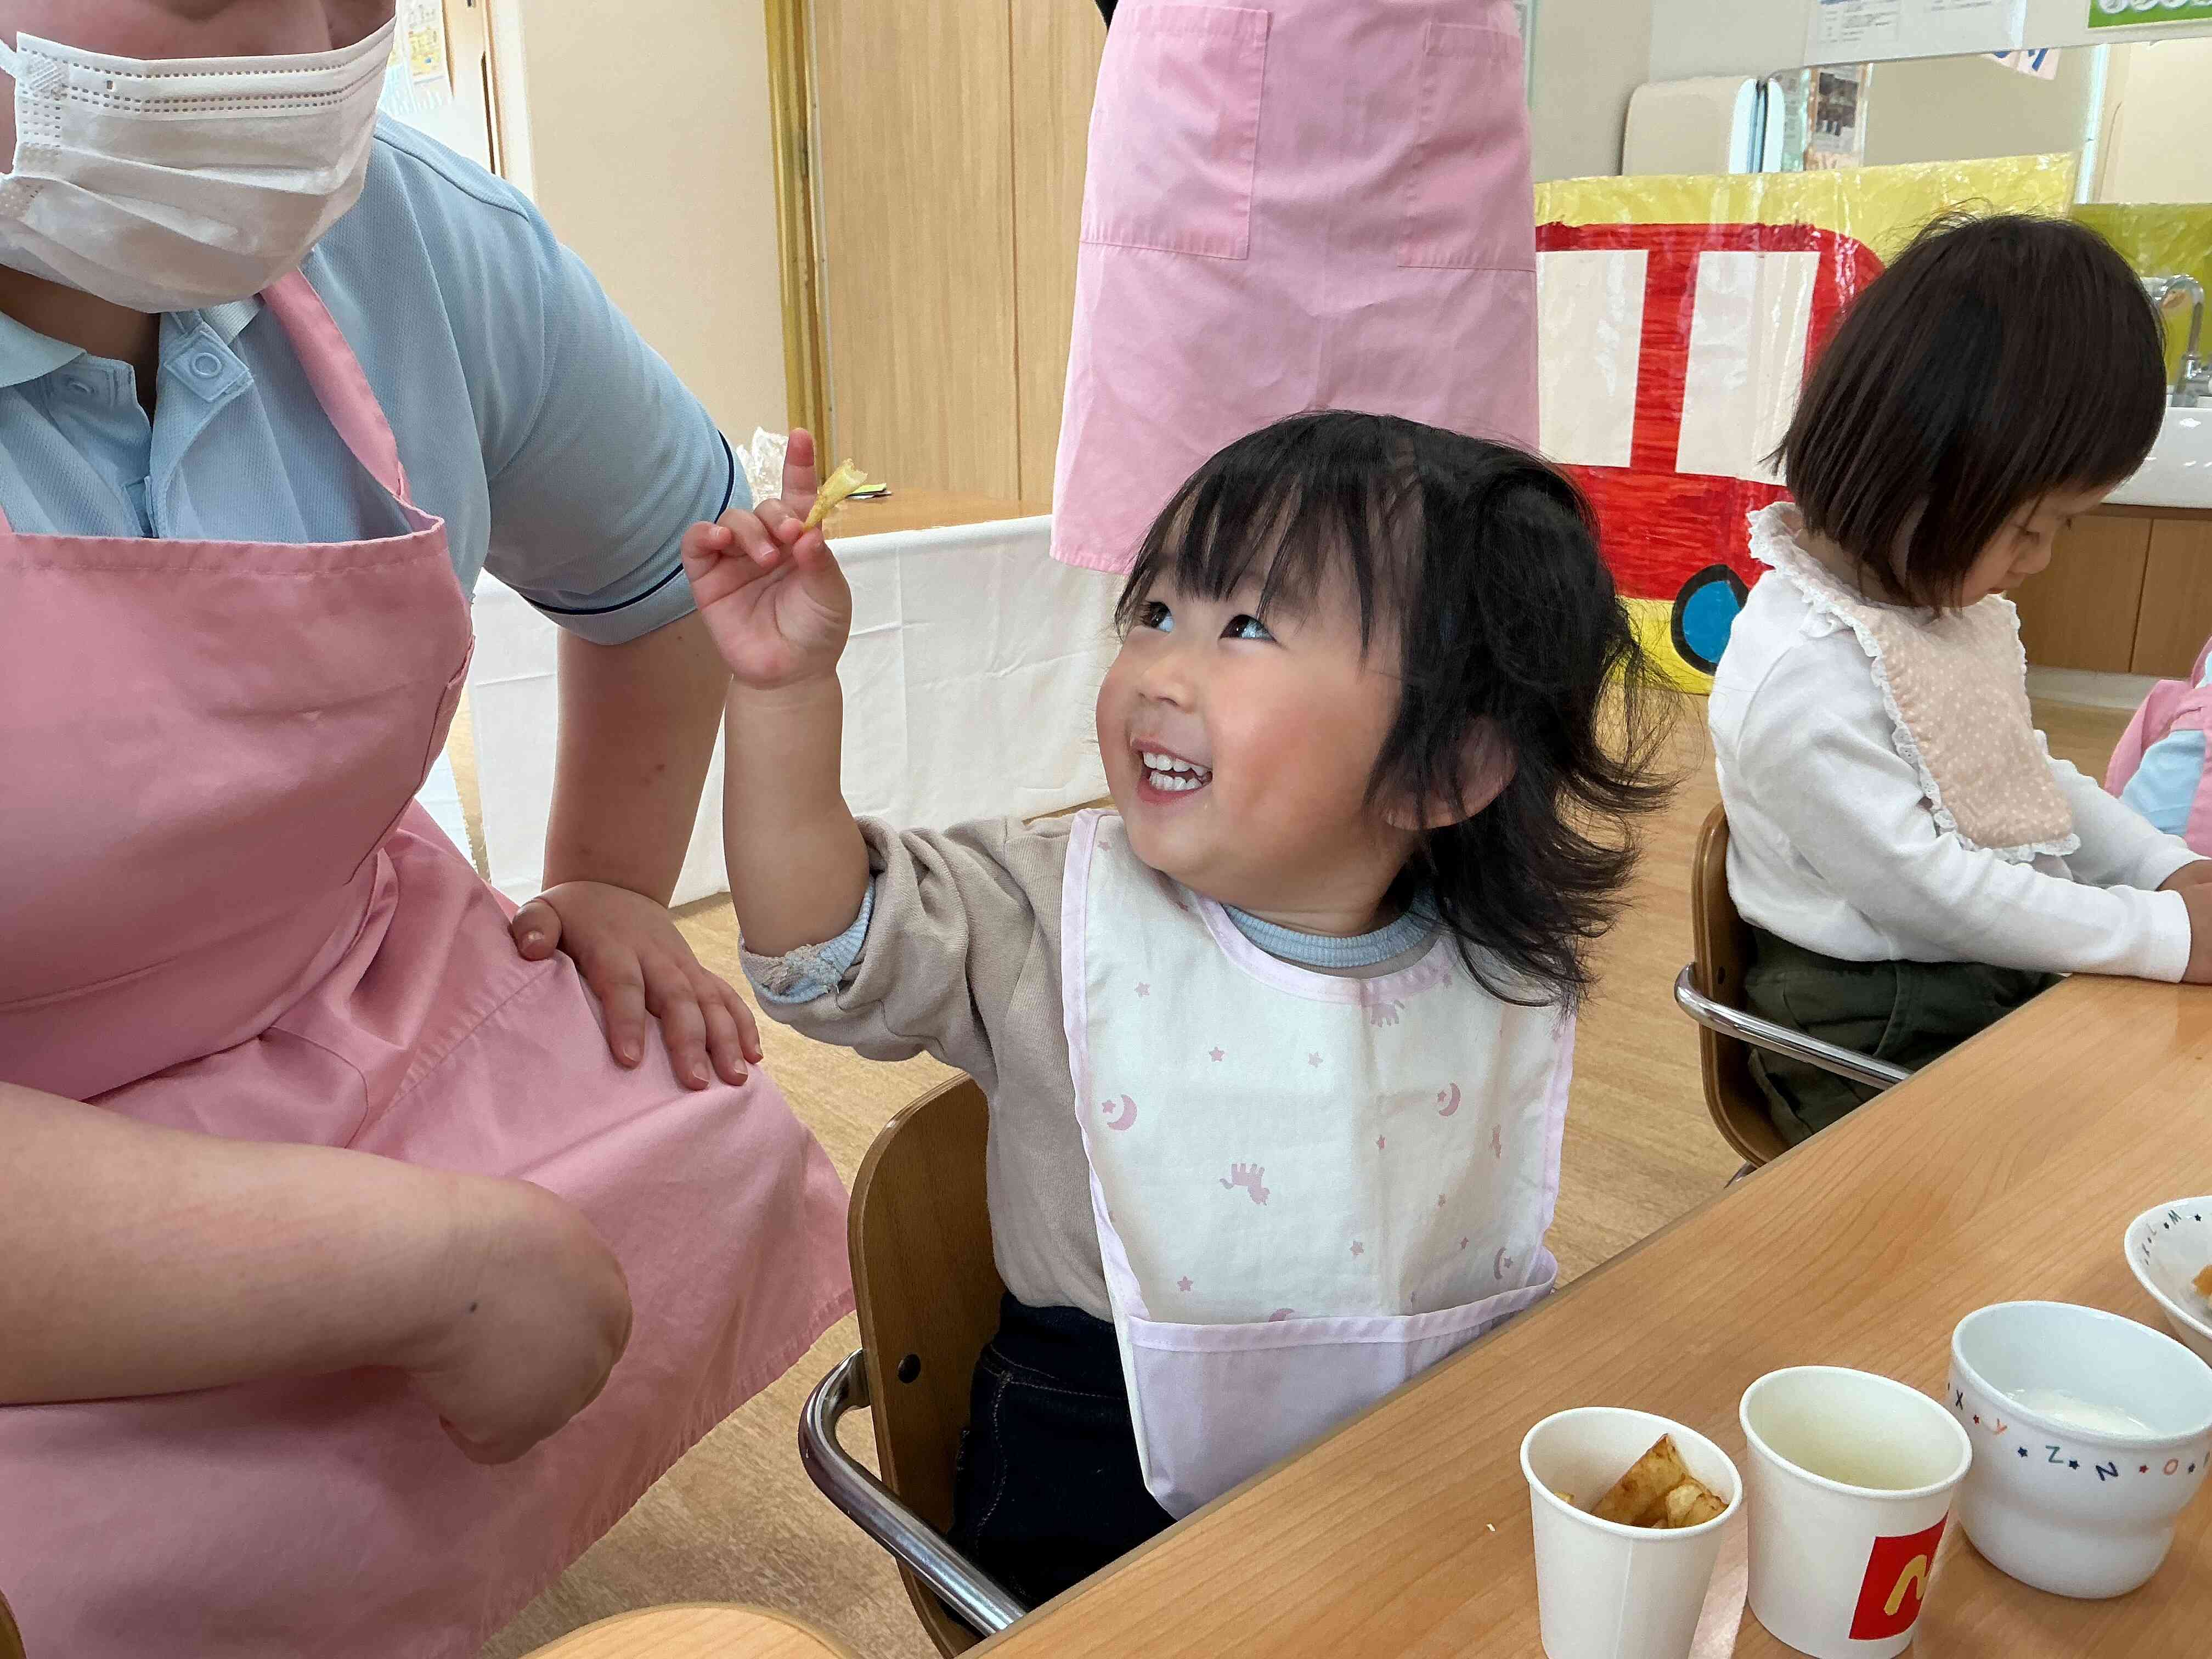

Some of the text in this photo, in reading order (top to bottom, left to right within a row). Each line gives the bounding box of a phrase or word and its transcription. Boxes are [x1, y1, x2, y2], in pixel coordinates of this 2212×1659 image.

[1955, 1390, 1963, 1410] X
[2046, 1444, 2064, 1463] Z
[2095, 1462, 2119, 1481] N
[2163, 1458, 2179, 1475] O
